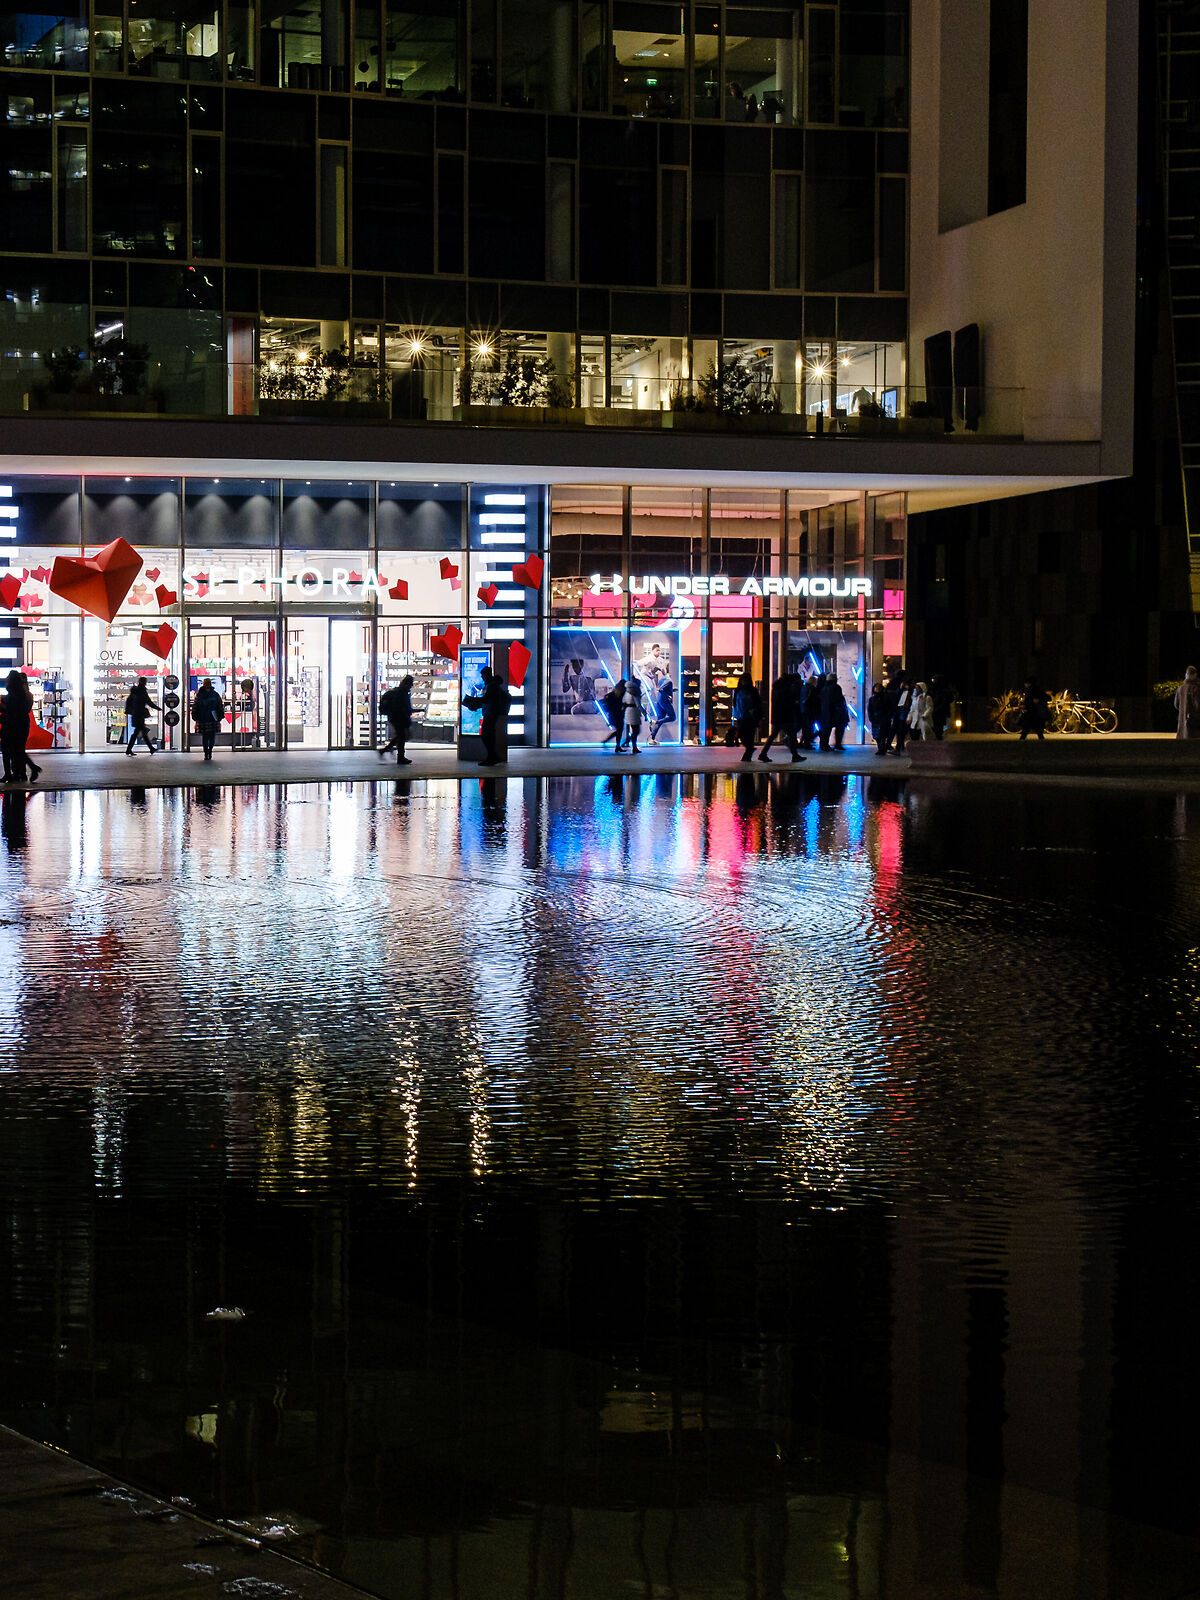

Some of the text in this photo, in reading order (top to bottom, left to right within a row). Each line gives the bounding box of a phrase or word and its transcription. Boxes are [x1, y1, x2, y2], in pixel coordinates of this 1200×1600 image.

[182, 566, 382, 597] SEPHORA
[629, 575, 873, 597] UNDER ARMOUR
